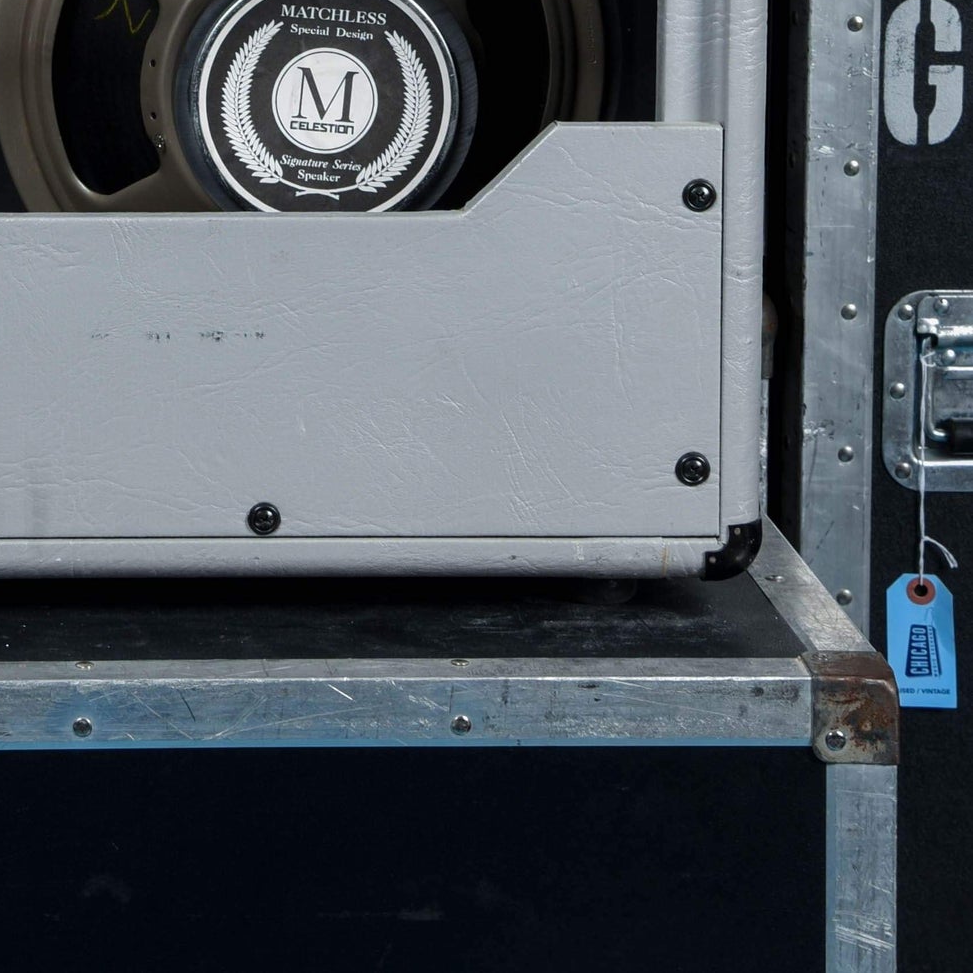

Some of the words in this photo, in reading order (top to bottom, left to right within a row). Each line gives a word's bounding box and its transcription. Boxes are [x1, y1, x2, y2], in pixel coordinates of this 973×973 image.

[280, 3, 388, 26] MATCHLESS
[290, 23, 330, 37] Special
[336, 27, 374, 41] Design
[291, 66, 360, 124] M
[289, 120, 355, 136] CELESTION
[279, 154, 329, 169] Signature
[332, 159, 362, 172] Series
[297, 169, 341, 183] Speaker
[910, 627, 930, 675] CHICAGO
